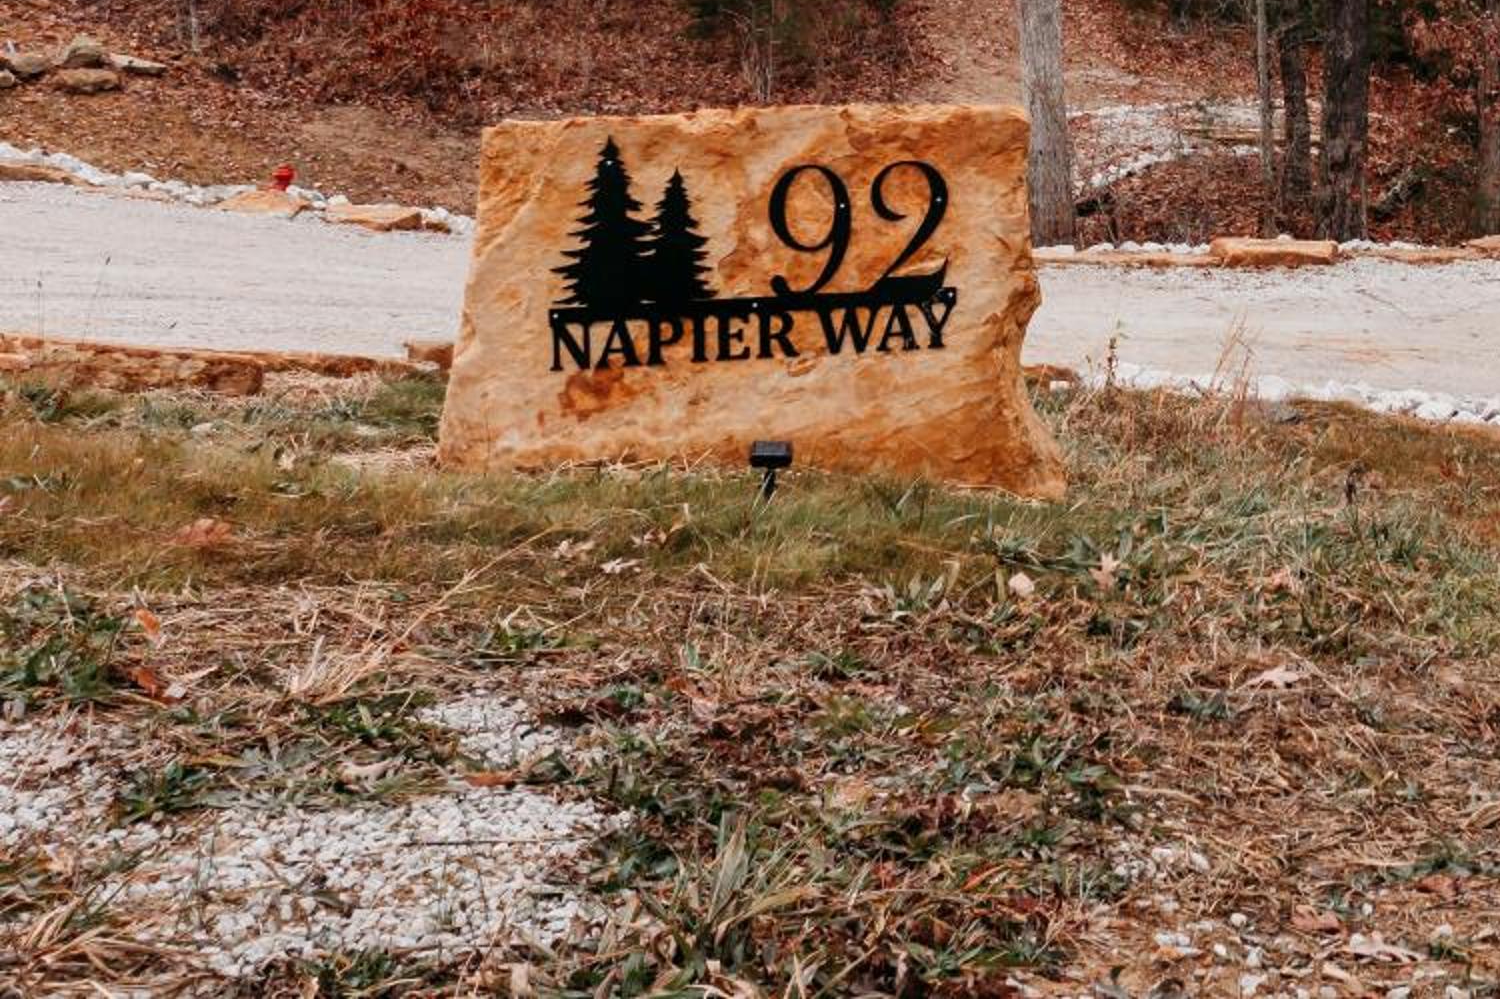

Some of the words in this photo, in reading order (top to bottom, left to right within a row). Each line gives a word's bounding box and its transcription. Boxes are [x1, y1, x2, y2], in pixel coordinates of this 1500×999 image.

[768, 160, 950, 298] 92
[549, 309, 802, 372] NAPIER
[818, 293, 957, 354] WAY
